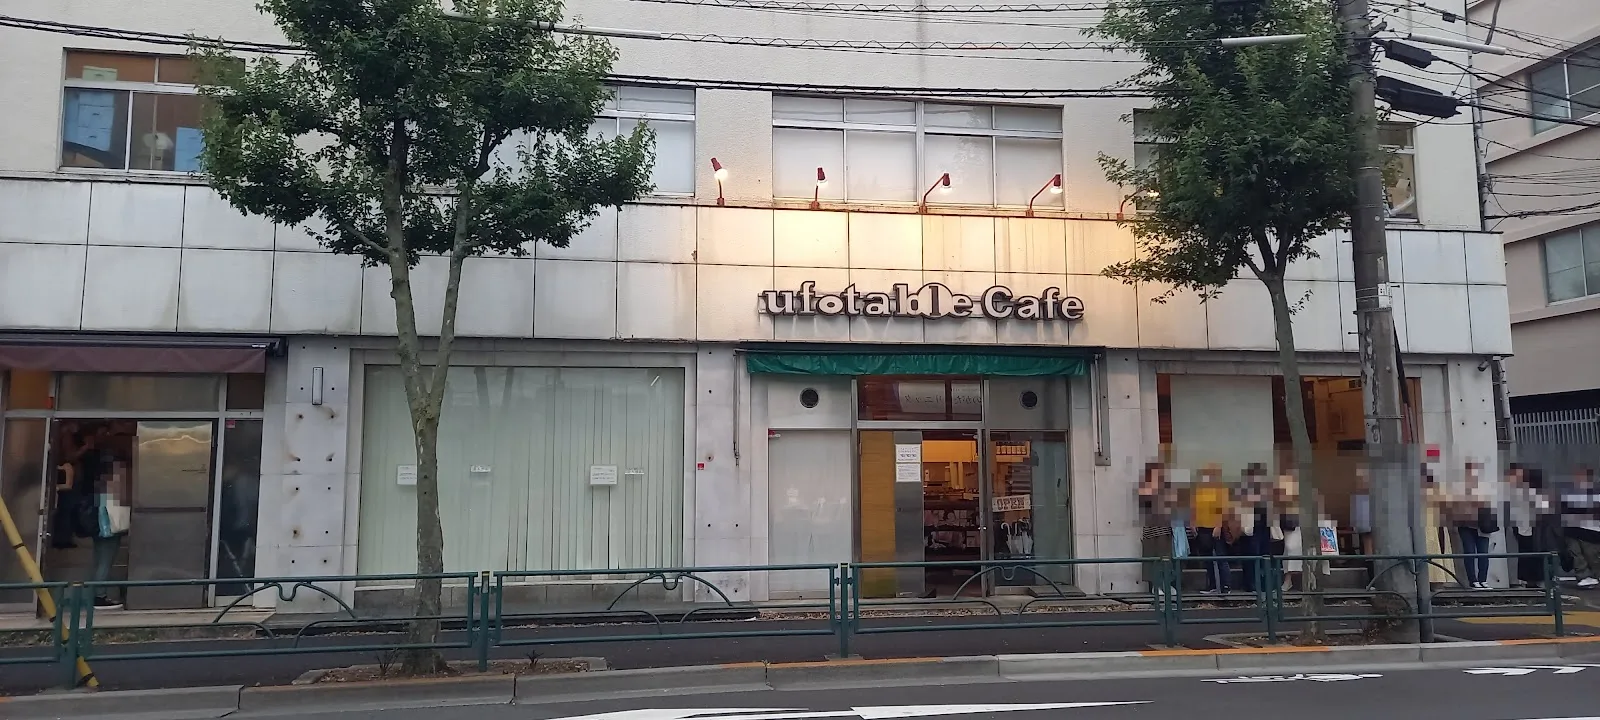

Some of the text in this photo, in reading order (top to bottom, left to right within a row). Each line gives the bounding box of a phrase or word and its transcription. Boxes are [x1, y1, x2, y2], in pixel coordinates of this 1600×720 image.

[762, 281, 1085, 321] ufotable Cafe
[996, 497, 1025, 511] OPEN
